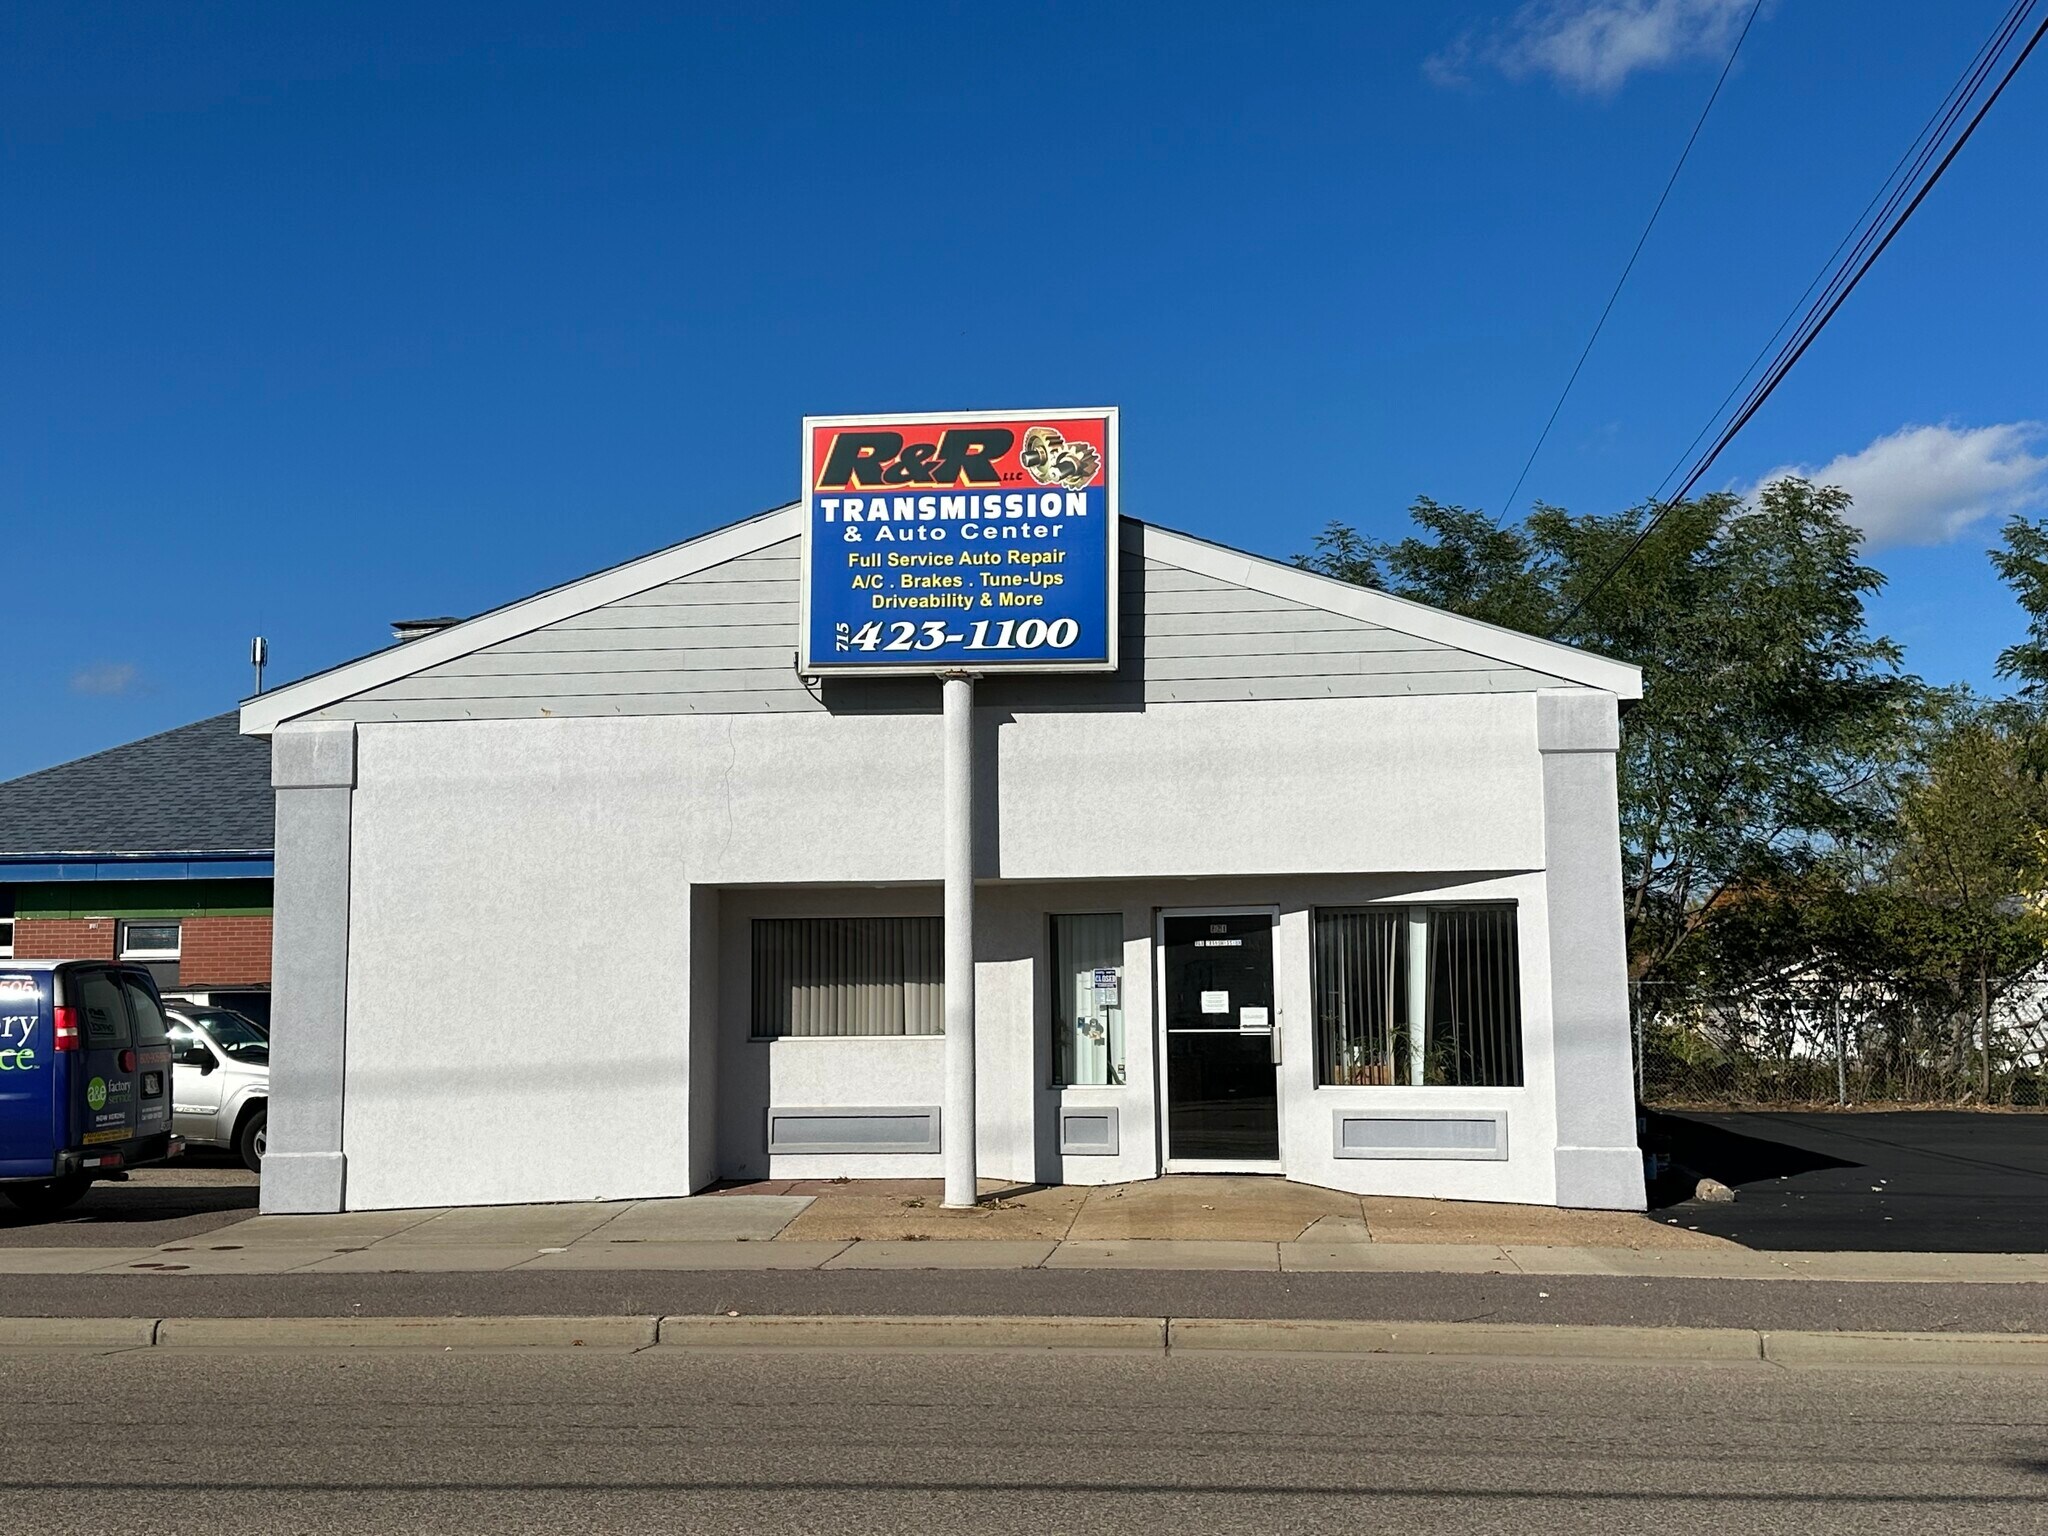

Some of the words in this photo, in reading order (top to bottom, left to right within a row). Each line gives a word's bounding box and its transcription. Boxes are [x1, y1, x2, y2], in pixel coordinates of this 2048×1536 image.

[816, 429, 1014, 490] R&R
[1003, 472, 1023, 482] LLC
[820, 492, 1087, 523] TRANSMISSION
[843, 525, 862, 542] &
[874, 525, 946, 542] Auto
[960, 522, 1063, 540] Center
[848, 552, 881, 568] Full
[887, 551, 954, 567] Service
[958, 550, 1002, 565] Auto
[1007, 548, 1066, 567] Repair
[851, 573, 884, 589] A/C
[900, 573, 963, 588] Brakes
[979, 571, 1064, 589] Tune-Ups
[871, 592, 974, 611] Driveability
[980, 592, 993, 607] &
[999, 591, 1044, 606] More
[836, 622, 850, 651] 715
[849, 618, 1079, 651] 423-1100
[0, 1015, 39, 1048] ry
[108, 1079, 131, 1094] factory
